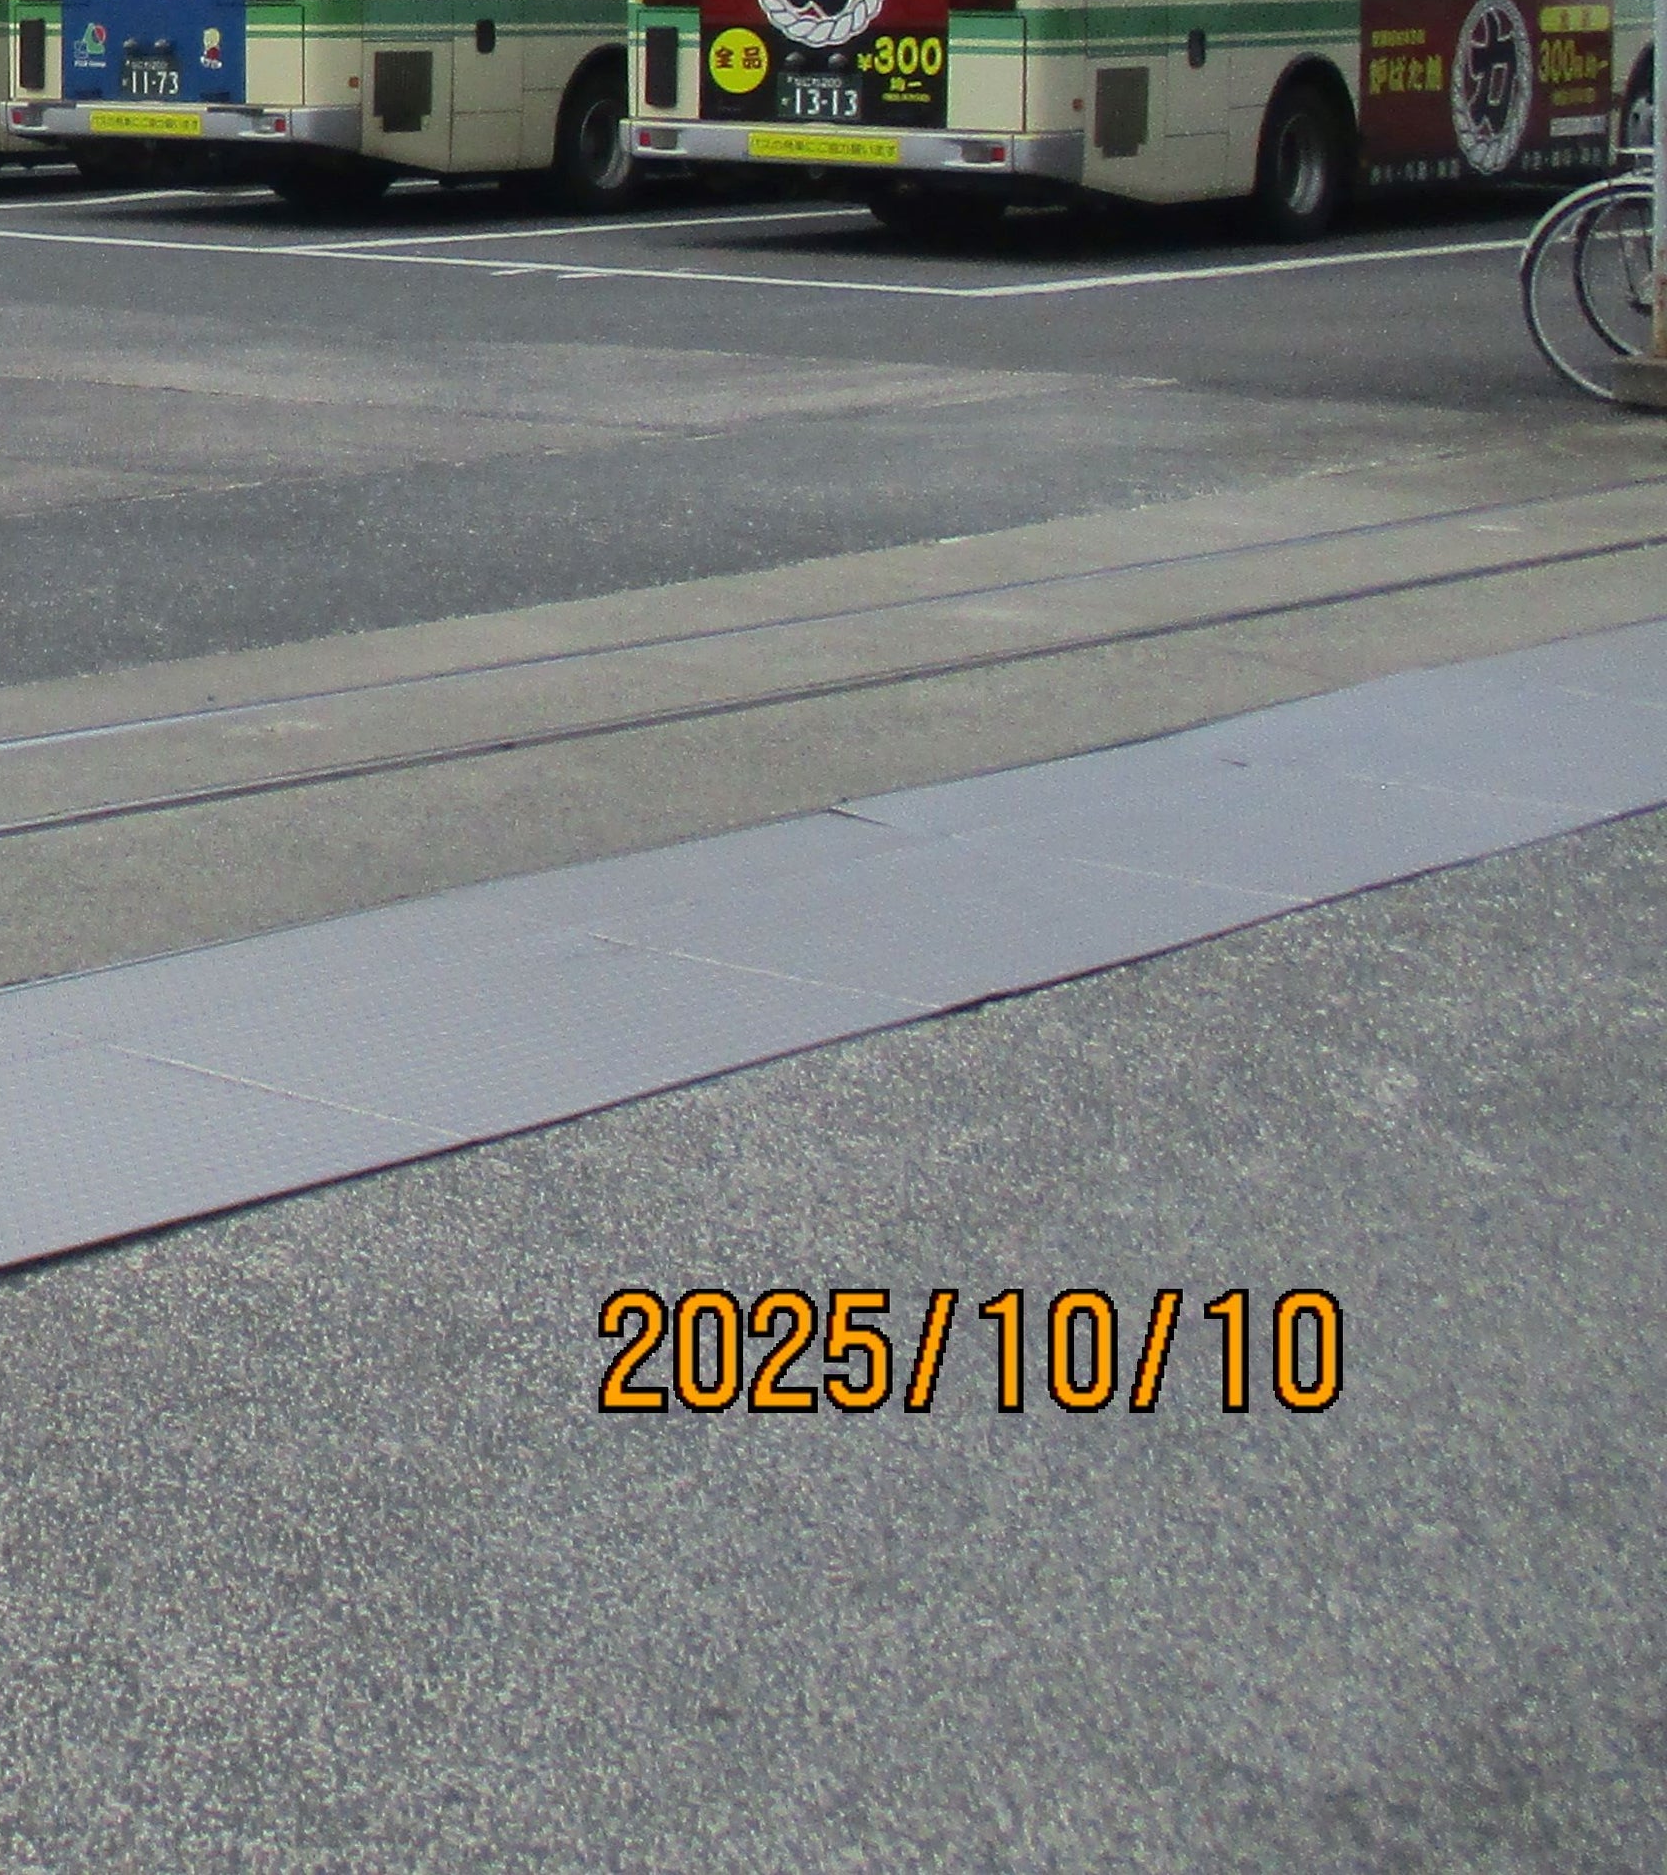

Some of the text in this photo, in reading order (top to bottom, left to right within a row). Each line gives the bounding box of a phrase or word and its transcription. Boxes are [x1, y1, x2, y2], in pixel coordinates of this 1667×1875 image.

[714, 46, 763, 70] 全品
[857, 36, 943, 75] ¥300
[130, 71, 180, 95] 11-73
[794, 88, 859, 116] 13-13
